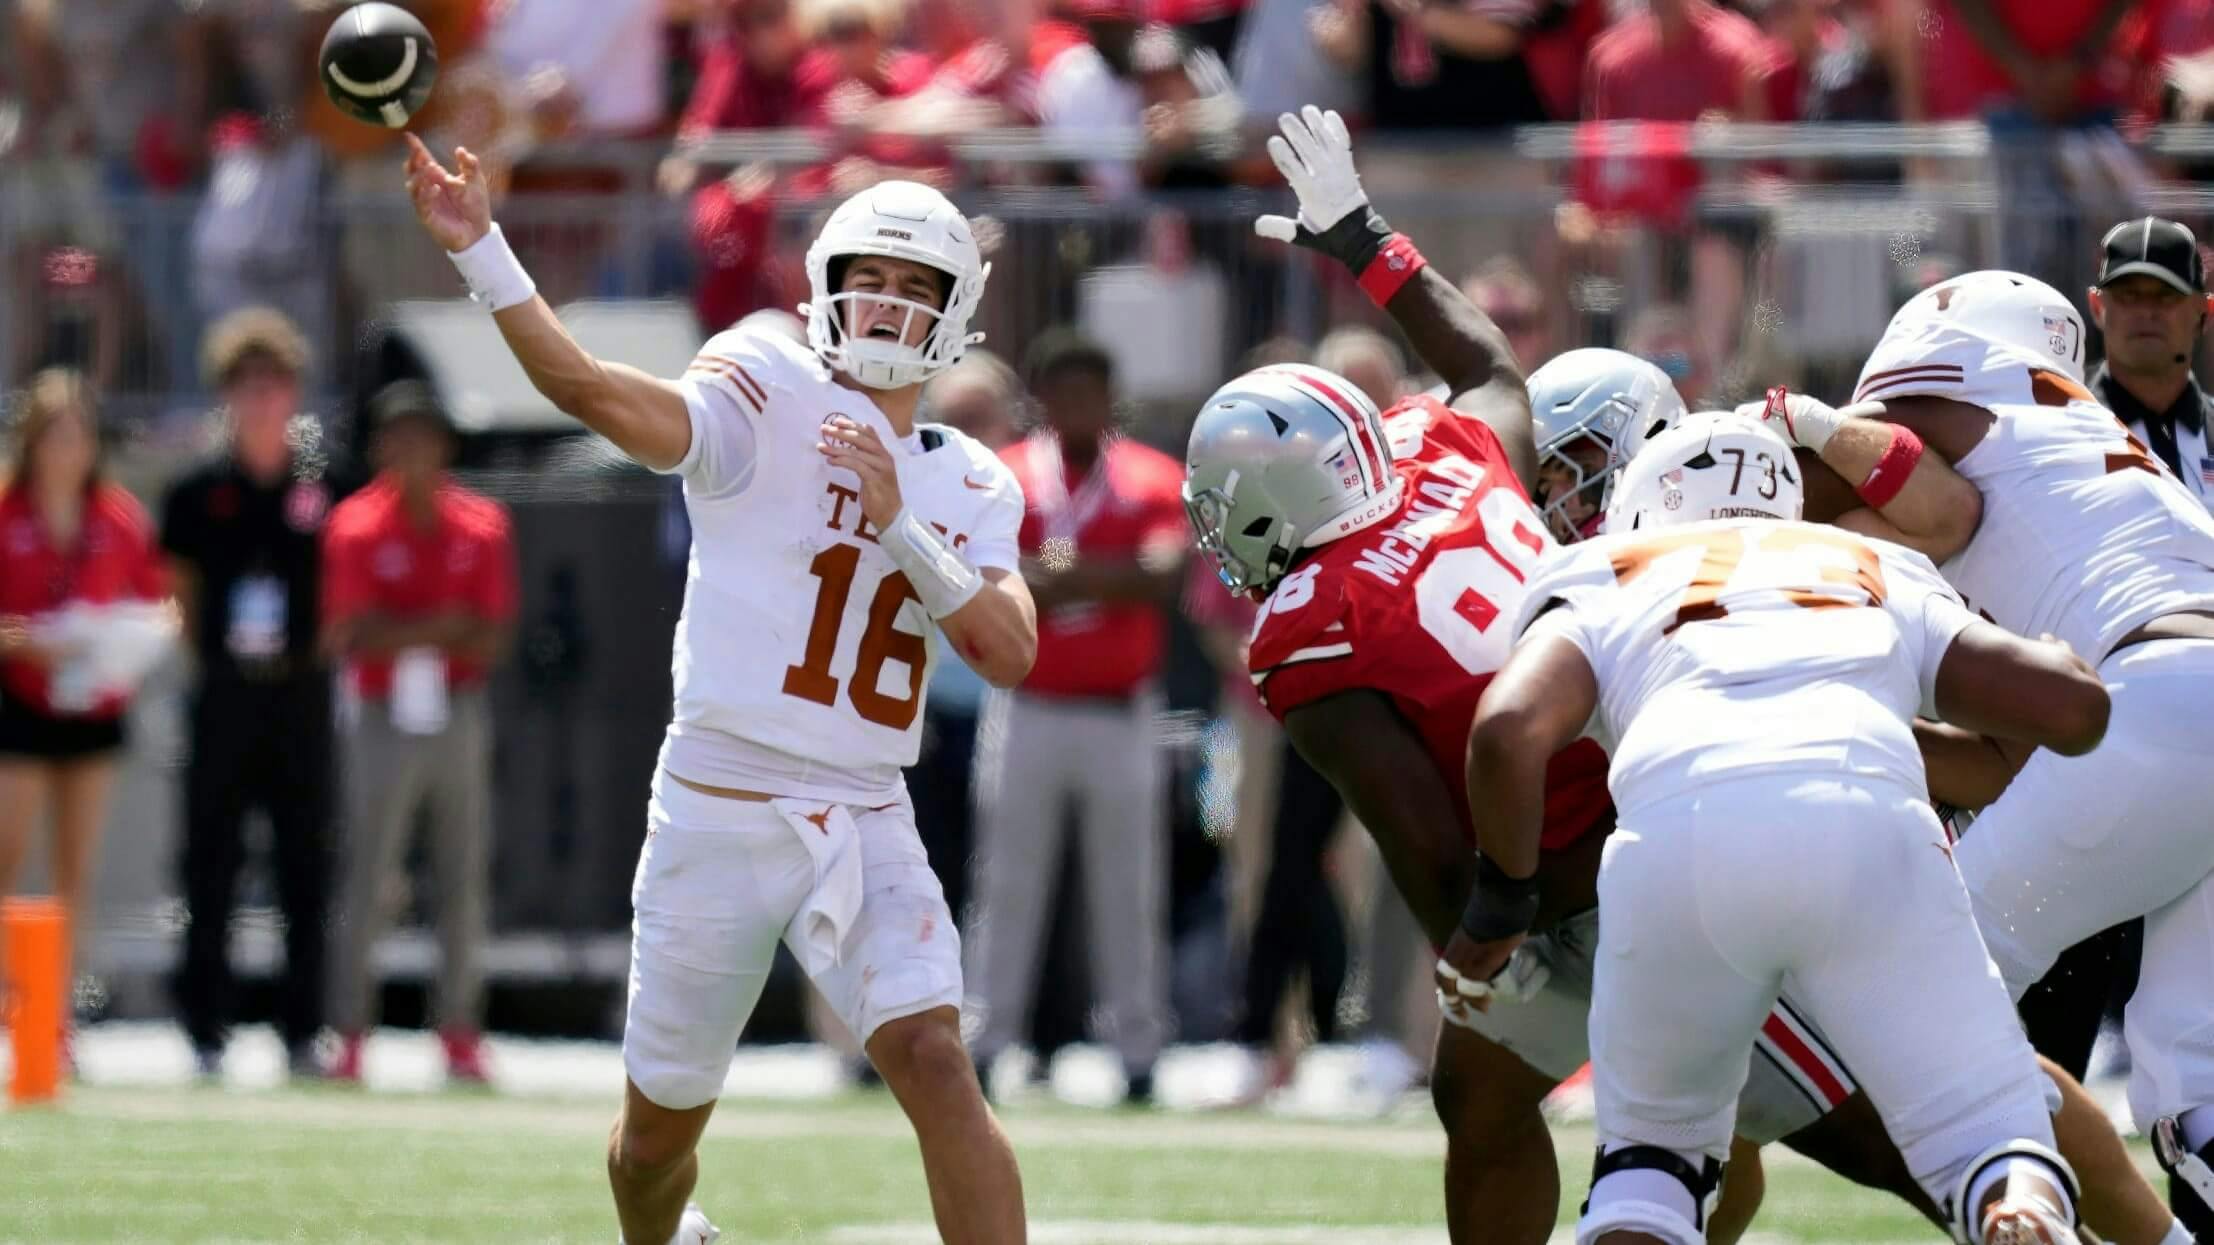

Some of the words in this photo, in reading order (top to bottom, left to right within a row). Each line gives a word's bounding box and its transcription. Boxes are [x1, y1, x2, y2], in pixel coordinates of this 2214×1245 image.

[877, 227, 912, 241] HORNS
[1722, 448, 1778, 500] 73
[782, 542, 927, 731] 16
